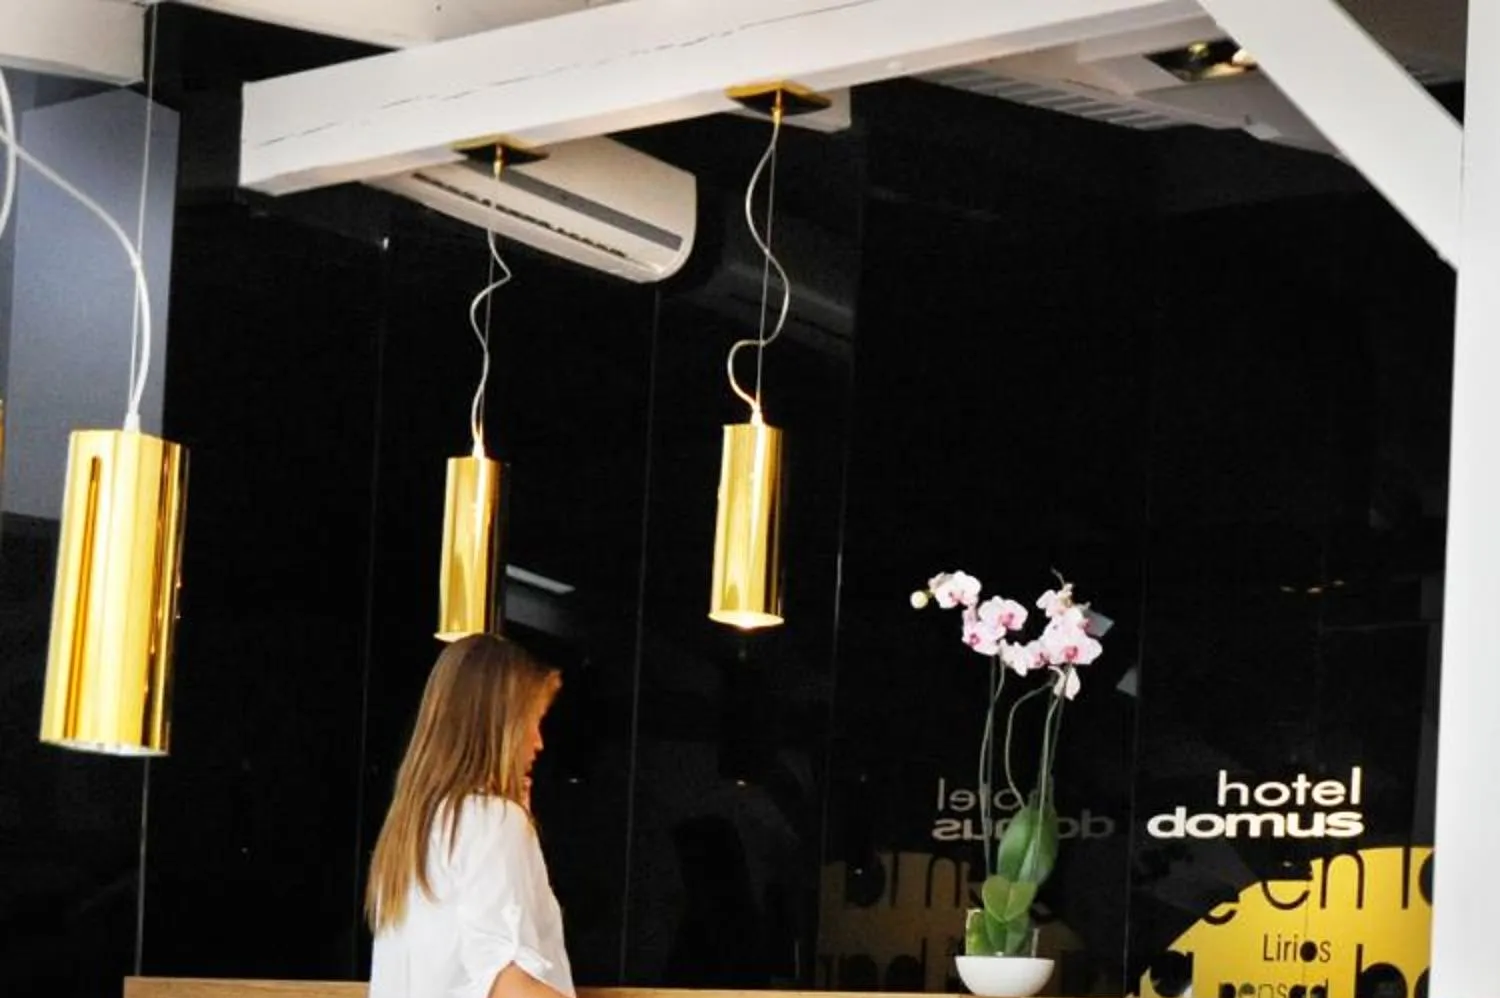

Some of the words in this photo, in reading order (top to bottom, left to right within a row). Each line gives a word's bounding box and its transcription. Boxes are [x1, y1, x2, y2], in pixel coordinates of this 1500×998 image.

[1217, 765, 1363, 807] hotel
[1146, 804, 1366, 839] domus
[1262, 933, 1332, 963] Lirios
